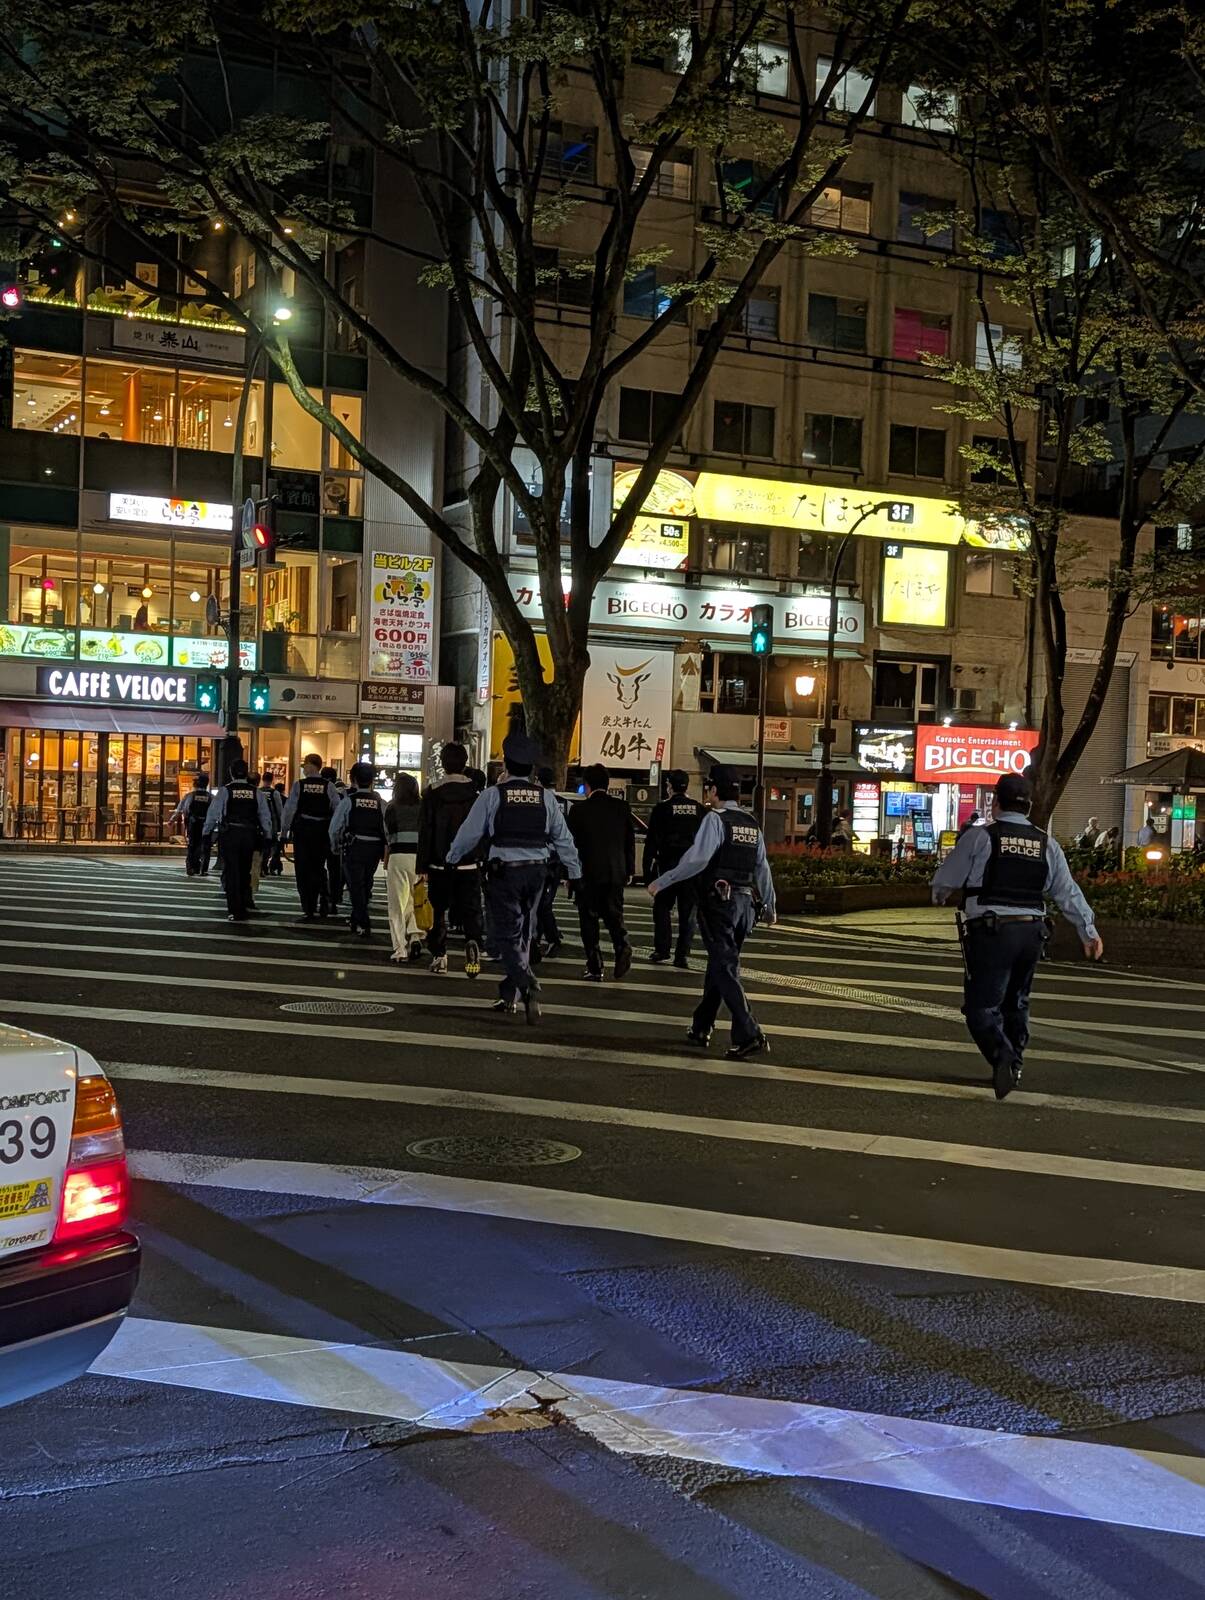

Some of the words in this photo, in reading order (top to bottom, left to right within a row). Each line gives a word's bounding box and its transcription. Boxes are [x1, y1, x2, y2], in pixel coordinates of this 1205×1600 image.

[160, 331, 199, 351] 泰山
[891, 503, 910, 521] 3F
[887, 545, 899, 556] 3F
[374, 553, 434, 573] 当ビル2F
[382, 582, 425, 608] らら亭
[607, 598, 639, 615] BIG
[642, 600, 688, 621] ECHO
[699, 602, 754, 624] カラオ
[784, 611, 815, 629] BIG
[816, 615, 859, 633] ECHO
[374, 628, 428, 644] 600円
[115, 674, 187, 702] VELOCE
[367, 684, 409, 697] 俺の床屋
[411, 690, 423, 700] 3F
[601, 715, 652, 729] 炭火牛たん
[600, 731, 652, 761] 仙牛
[935, 735, 966, 744] Karaoke
[968, 736, 1022, 747] Entertainment
[924, 745, 968, 771] BIG
[970, 749, 1032, 774] ECHO
[507, 796, 541, 804] POLICE
[732, 833, 758, 845] POLICE
[1001, 845, 1041, 858] POLICE
[0, 1115, 56, 1165] 39
